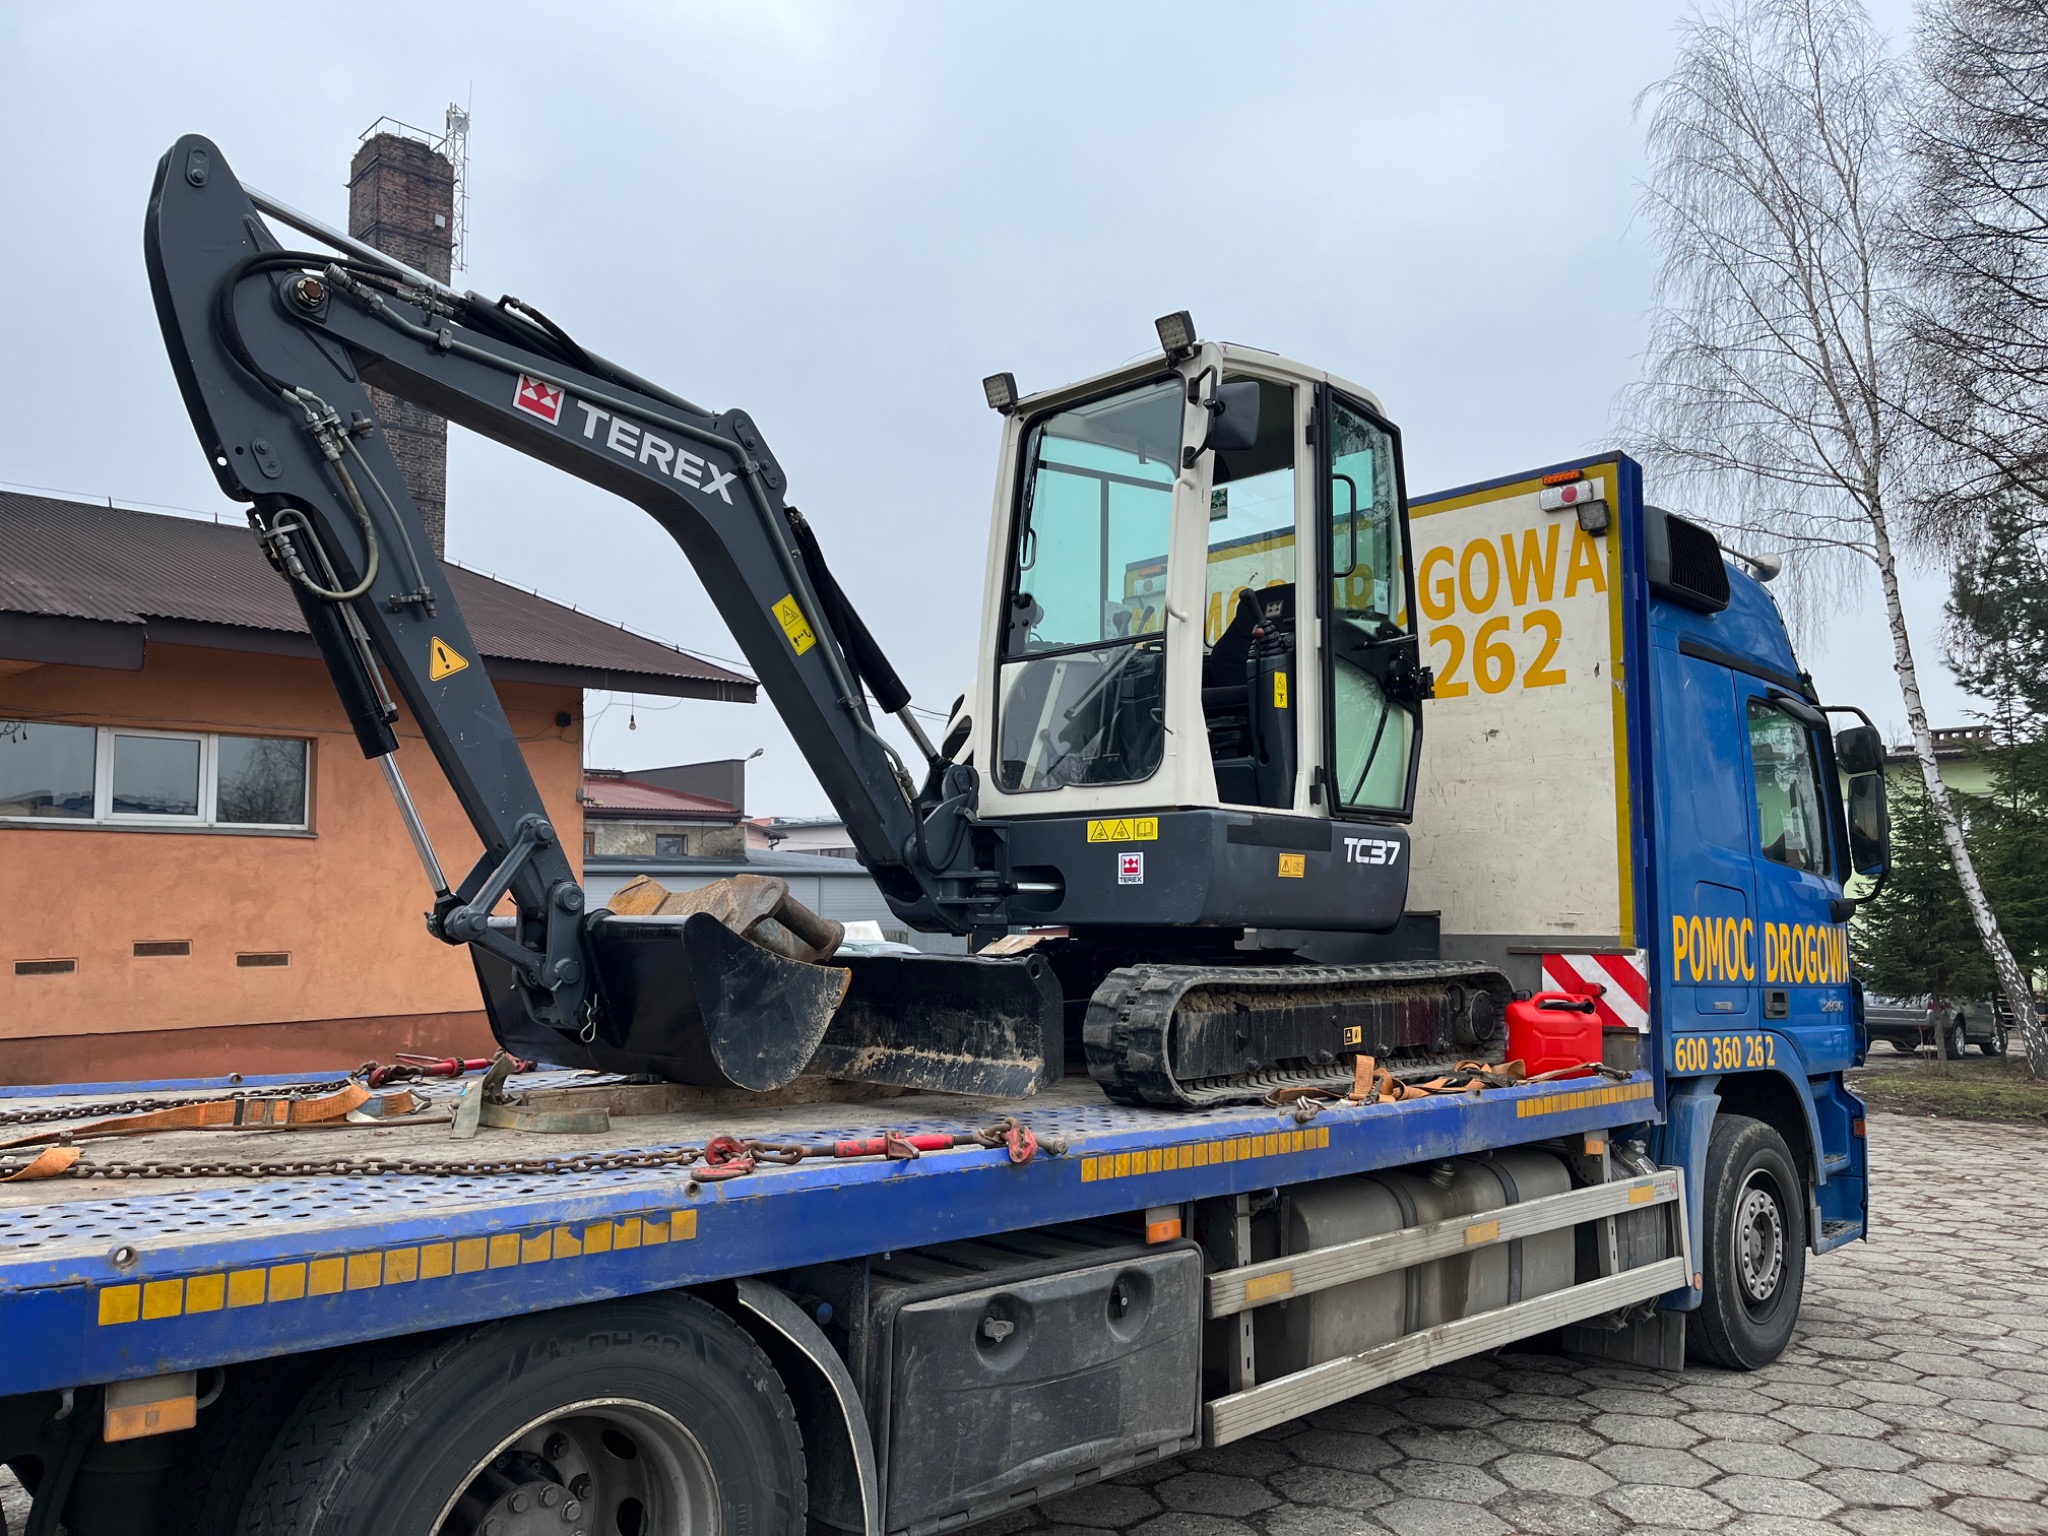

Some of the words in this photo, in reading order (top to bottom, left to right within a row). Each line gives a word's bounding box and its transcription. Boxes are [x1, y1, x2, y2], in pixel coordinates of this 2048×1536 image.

[577, 400, 738, 506] TEREX
[1429, 608, 1568, 699] 262
[1343, 837, 1401, 865] TC37
[1119, 876, 1142, 884] TEREX
[1672, 915, 1755, 982] POMOC
[1764, 921, 1850, 984] DROGOWA
[1674, 1037, 1709, 1072] 600
[1712, 1036, 1742, 1070] 360
[1746, 1035, 1776, 1067] 262
